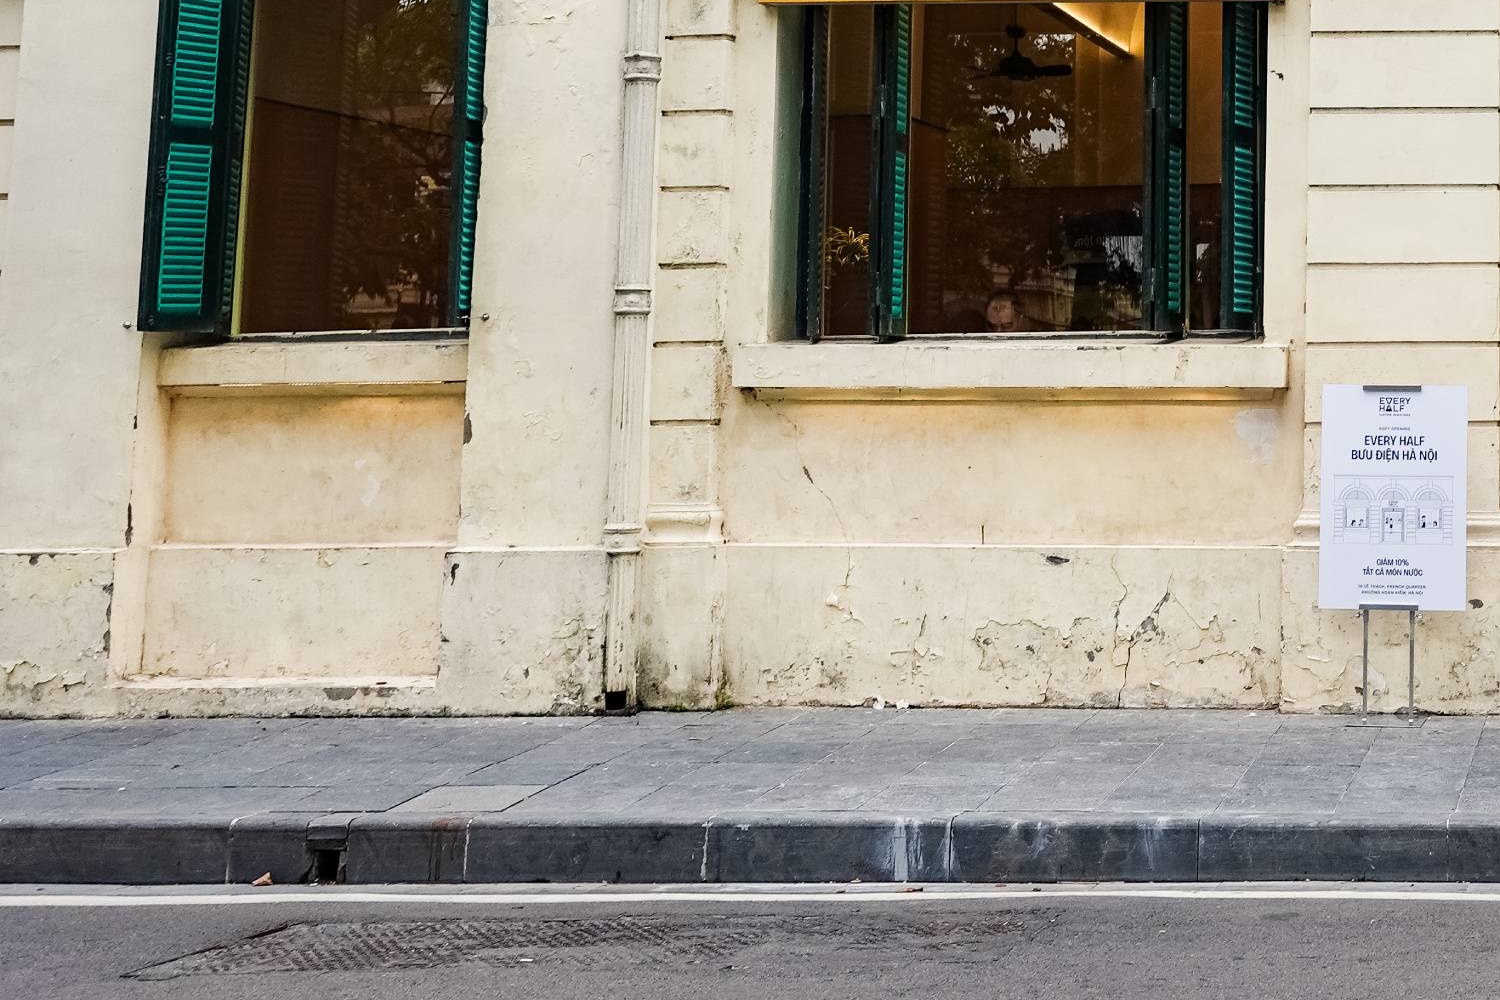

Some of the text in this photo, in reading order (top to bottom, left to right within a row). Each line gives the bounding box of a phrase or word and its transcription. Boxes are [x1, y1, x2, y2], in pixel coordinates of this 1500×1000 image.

[1379, 397, 1411, 405] EVERY
[1364, 435, 1425, 446] EVERY HALF
[1351, 448, 1438, 463] BƯU ĐIỆN HÀ NỘI
[1395, 558, 1410, 566] 10%
